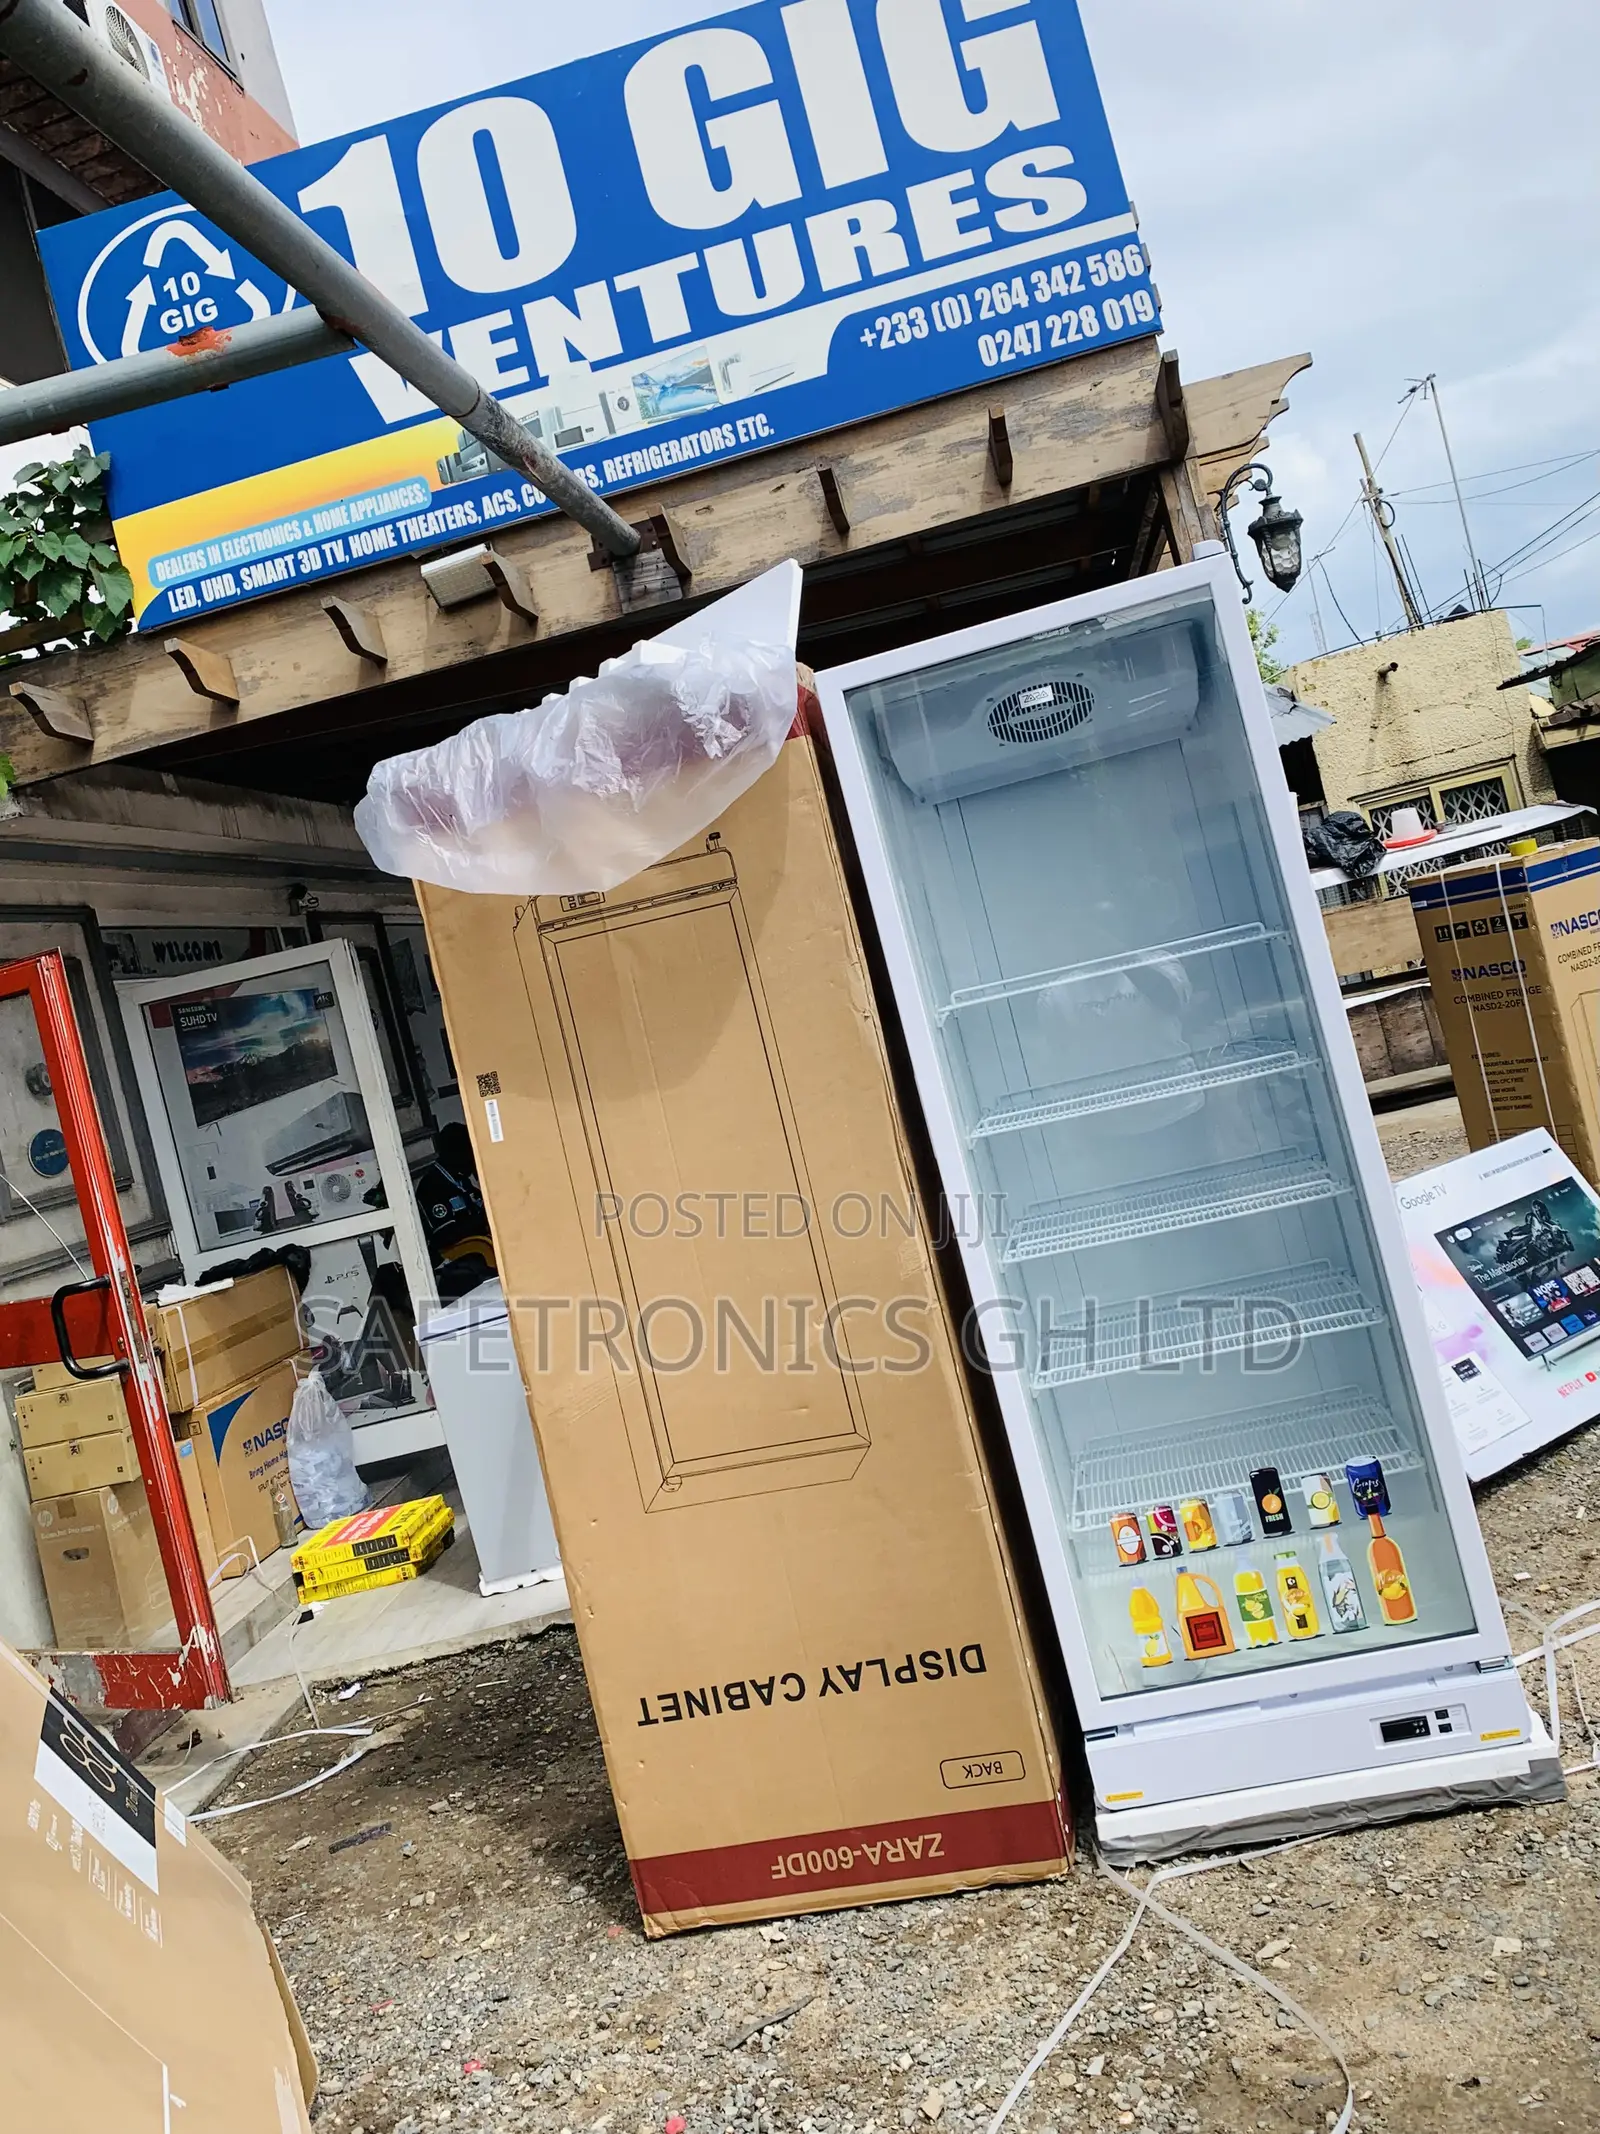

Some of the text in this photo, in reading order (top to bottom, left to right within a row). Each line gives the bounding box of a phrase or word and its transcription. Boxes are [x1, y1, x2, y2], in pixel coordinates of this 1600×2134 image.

[297, 0, 1061, 317] 10 GIG
[163, 271, 200, 302] 10
[348, 145, 1087, 424] VENTURES
[860, 243, 1145, 349] +233 (0) 264 342 586
[160, 297, 219, 334] GIG
[977, 289, 1155, 367] 0247 228 019
[167, 584, 202, 613] LED,
[201, 573, 241, 603] UHD,
[240, 554, 297, 591] SMART
[299, 550, 323, 574] 3D
[321, 538, 350, 565] TV,
[348, 524, 398, 557] HOME
[397, 502, 483, 544] THEATERS,
[482, 488, 522, 518] ACS,
[603, 423, 737, 483] REFRIGERATORS
[740, 412, 775, 443] ETC.
[155, 485, 428, 583] DEALERS IN ELECTRONICS & HOME APPLIANCES:
[1559, 908, 1600, 937] NASC
[1462, 959, 1527, 981] NASCO
[1557, 945, 1593, 964] COMBINED
[1453, 990, 1504, 1005] COMBINED
[1400, 1182, 1448, 1210] Google TV
[1475, 1272, 1490, 1284] The
[1487, 1256, 1528, 1279] Mandalorian
[1532, 1280, 1560, 1297] NOPE
[253, 1417, 290, 1452] NASC
[1264, 1512, 1285, 1523] FRESH
[638, 1643, 987, 1727] DISPLAY CABINET
[963, 1760, 1003, 1779] BACK
[770, 1832, 945, 1880] ZARA-600DF
